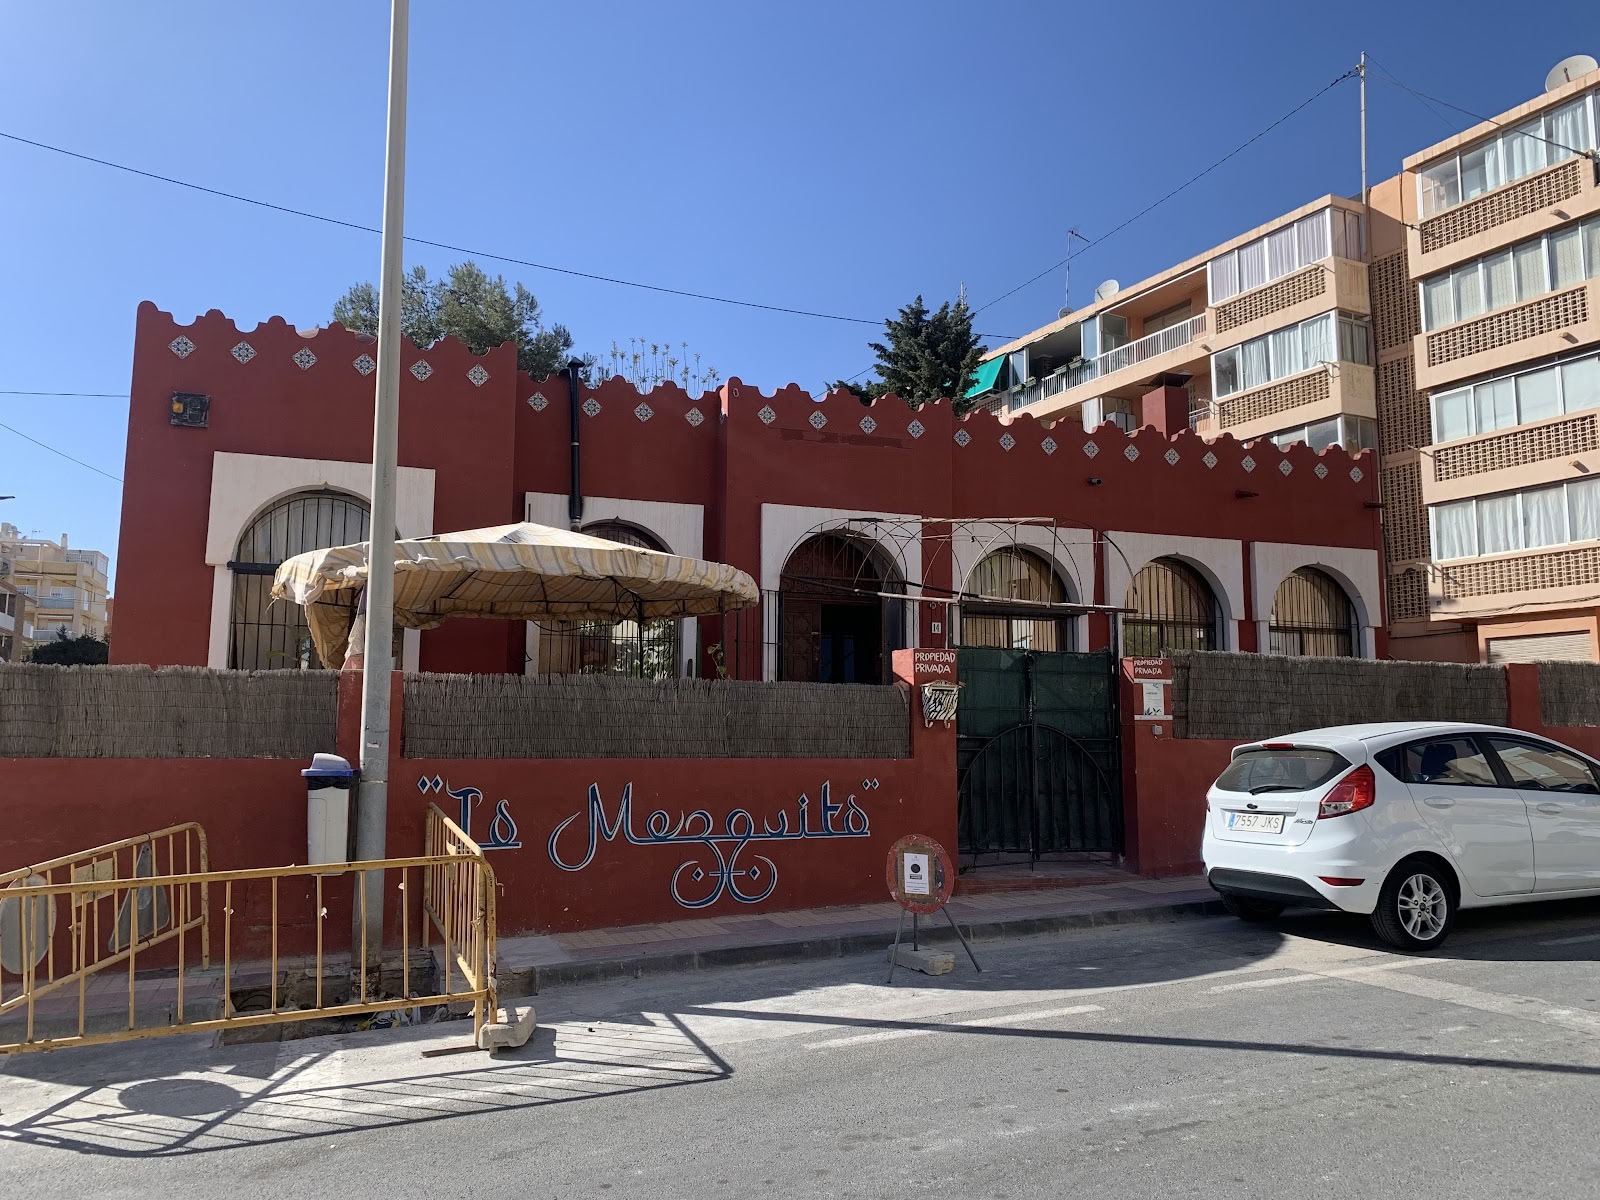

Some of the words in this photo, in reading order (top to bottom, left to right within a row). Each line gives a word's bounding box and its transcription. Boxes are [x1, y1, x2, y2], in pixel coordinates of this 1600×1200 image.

[914, 652, 956, 663] PROPIEDAD
[915, 663, 951, 674] PRIVADA
[1134, 667, 1162, 675] PRIVADA
[1235, 814, 1259, 827] 7557
[1261, 816, 1280, 829] JKS
